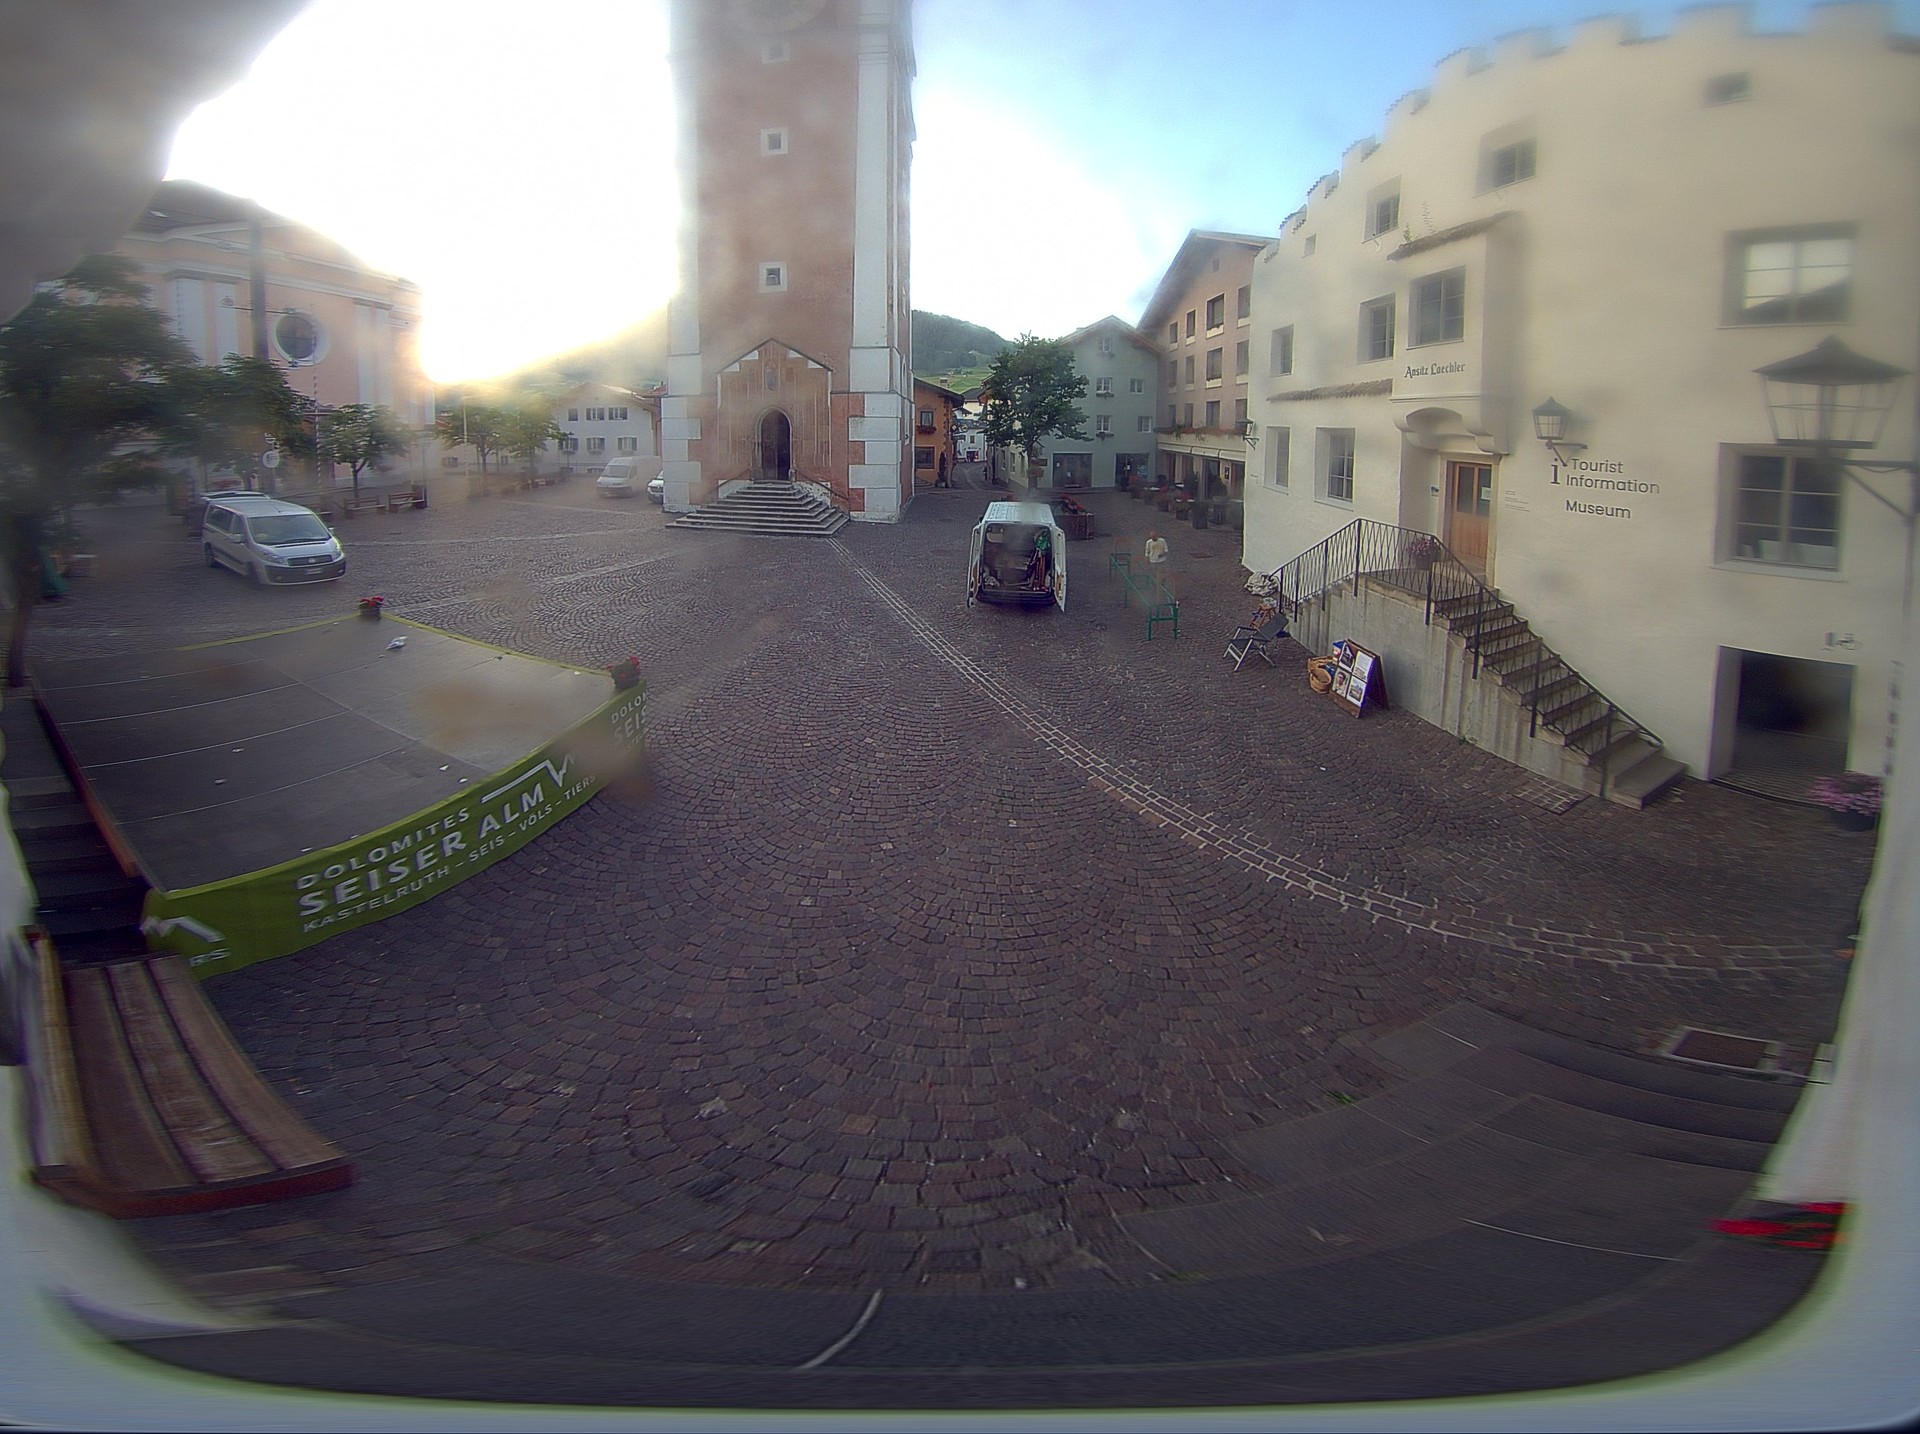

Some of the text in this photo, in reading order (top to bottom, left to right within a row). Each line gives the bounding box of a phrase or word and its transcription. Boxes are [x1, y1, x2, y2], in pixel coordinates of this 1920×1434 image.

[1566, 474, 1660, 495] Information
[1571, 458, 1624, 474] Tourist
[1565, 499, 1631, 519] Museum
[296, 807, 469, 890] DOLOMITES
[299, 782, 545, 917] SEISER ALM
[303, 865, 450, 933] KASTELRUTH
[469, 834, 506, 863] SEIS
[518, 803, 554, 832] VÖLS
[563, 774, 596, 800] TIERS
